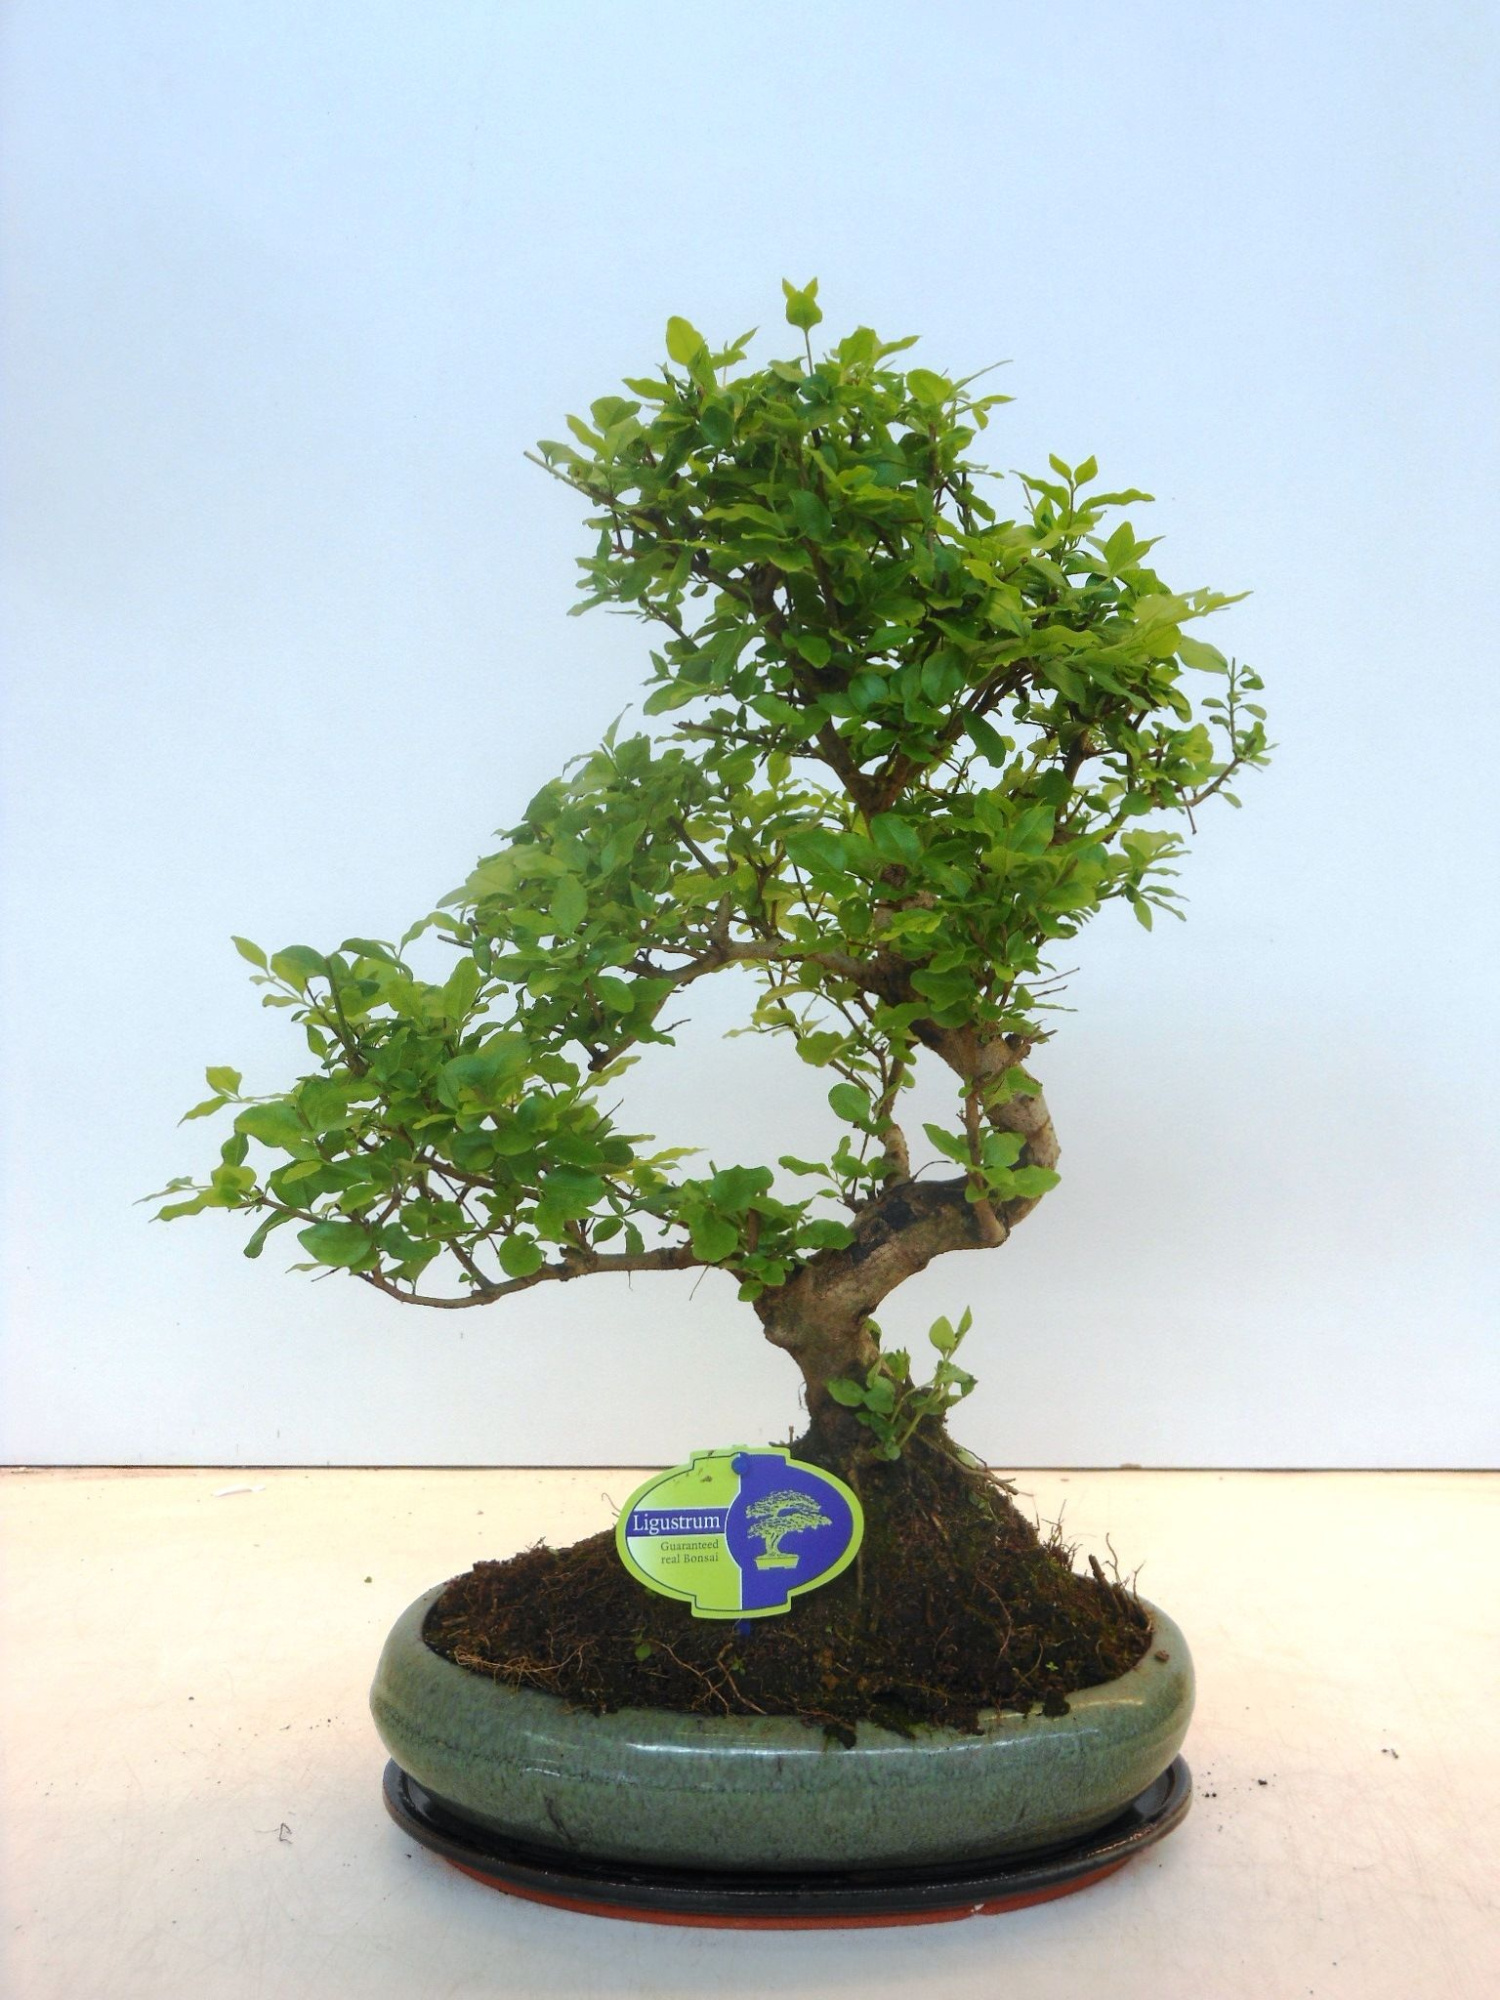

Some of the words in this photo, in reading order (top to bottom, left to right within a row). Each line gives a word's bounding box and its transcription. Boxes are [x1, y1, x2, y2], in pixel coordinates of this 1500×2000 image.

[632, 1514, 721, 1535] Ligustrum
[660, 1539, 719, 1552] Guaranteed
[660, 1553, 680, 1564] real
[684, 1552, 719, 1563] Bonsai
